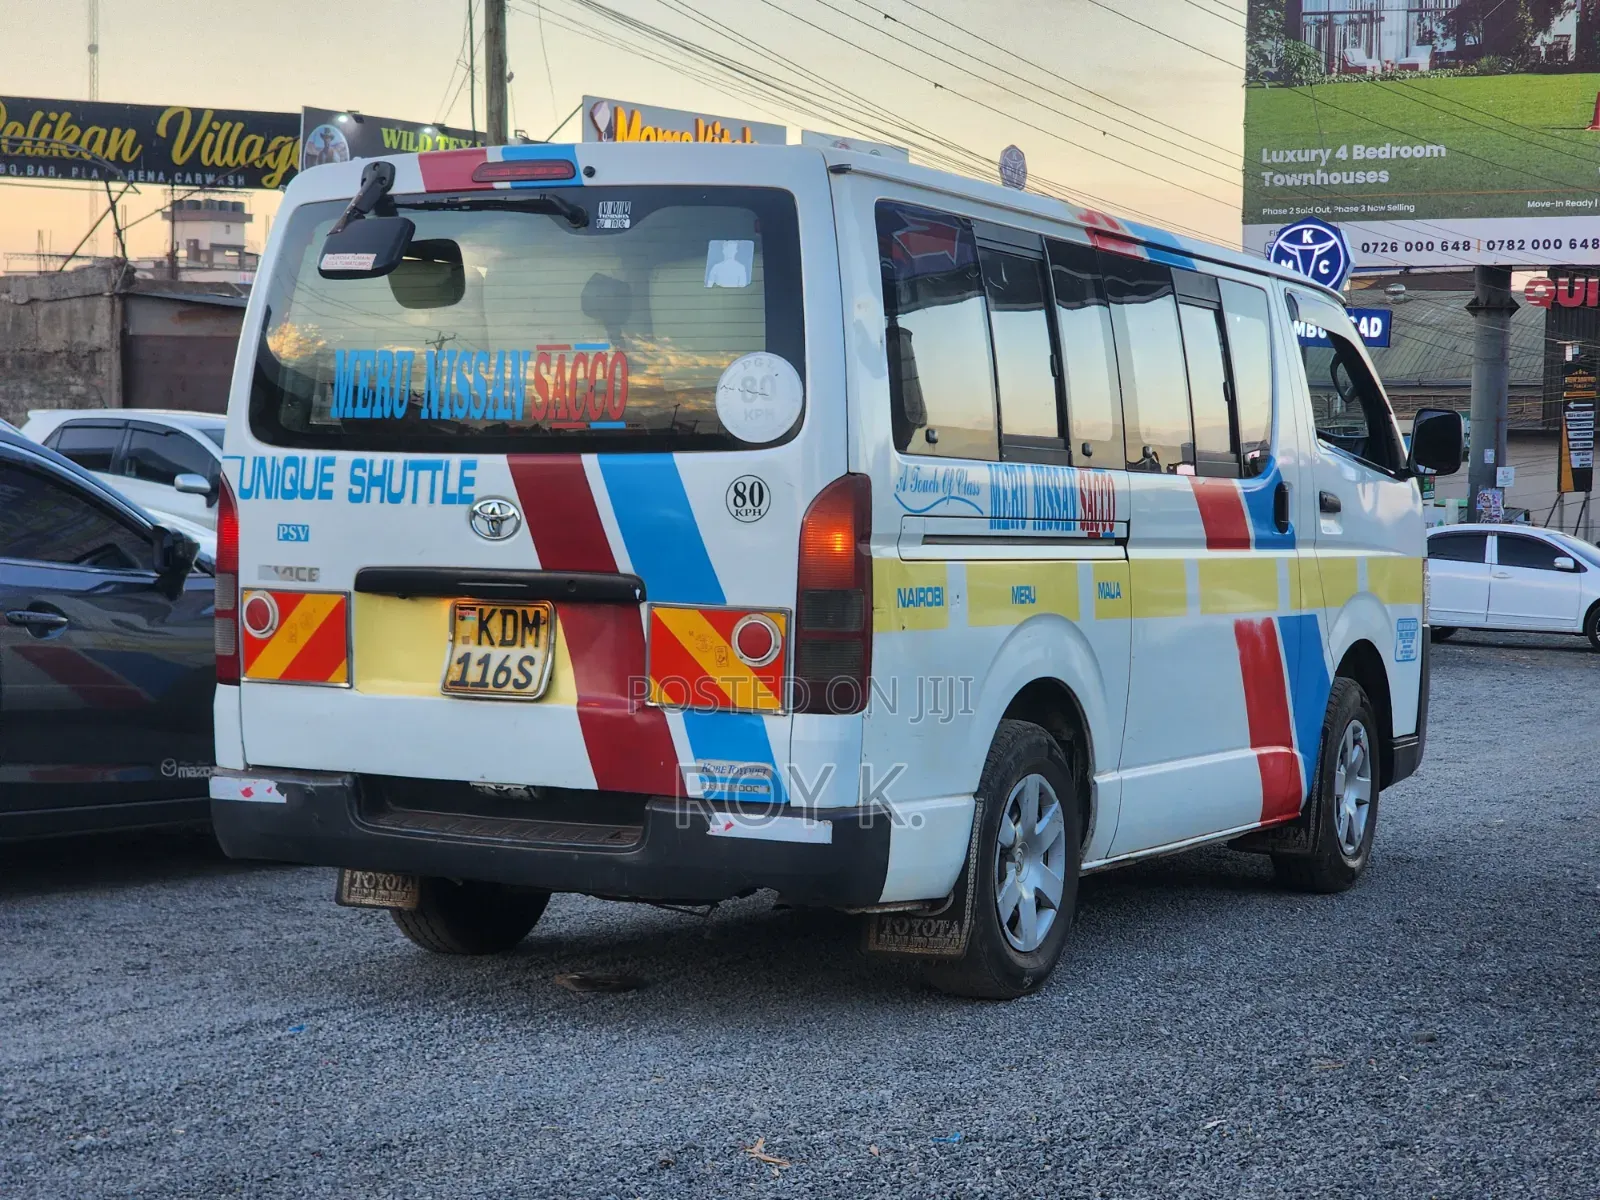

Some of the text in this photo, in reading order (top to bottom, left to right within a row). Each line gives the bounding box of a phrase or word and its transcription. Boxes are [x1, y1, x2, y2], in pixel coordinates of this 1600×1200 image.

[381, 127, 433, 152] WILD
[1261, 143, 1447, 166] Luxury 4 Bedroom
[1261, 169, 1390, 187] Townhouses
[1262, 207, 1288, 216] Phase
[1295, 206, 1314, 214] Sold
[1387, 203, 1415, 213] Selling
[1527, 199, 1593, 209] Move-In Ready
[1302, 229, 1314, 244] K
[1361, 238, 1600, 253] 0726 000 648 0782 000 648
[1318, 259, 1330, 274] C
[330, 348, 629, 422] MERU NISSAN SACCO
[740, 374, 777, 404] 80
[743, 407, 776, 422] KPH
[222, 456, 478, 505] UNIQUE SHUTTLE
[733, 481, 764, 508] 80
[987, 463, 1116, 533] MERU NISSAN SACCO
[735, 508, 762, 517] KPH
[278, 525, 309, 540] PSV
[897, 586, 944, 608] NAIROBI
[1011, 586, 1036, 604] MERU
[1098, 581, 1122, 599] MAUA
[478, 607, 541, 648] KDM
[449, 652, 536, 690] 116S
[353, 871, 413, 892] TOYOTA
[882, 916, 960, 938] TOYOTA
